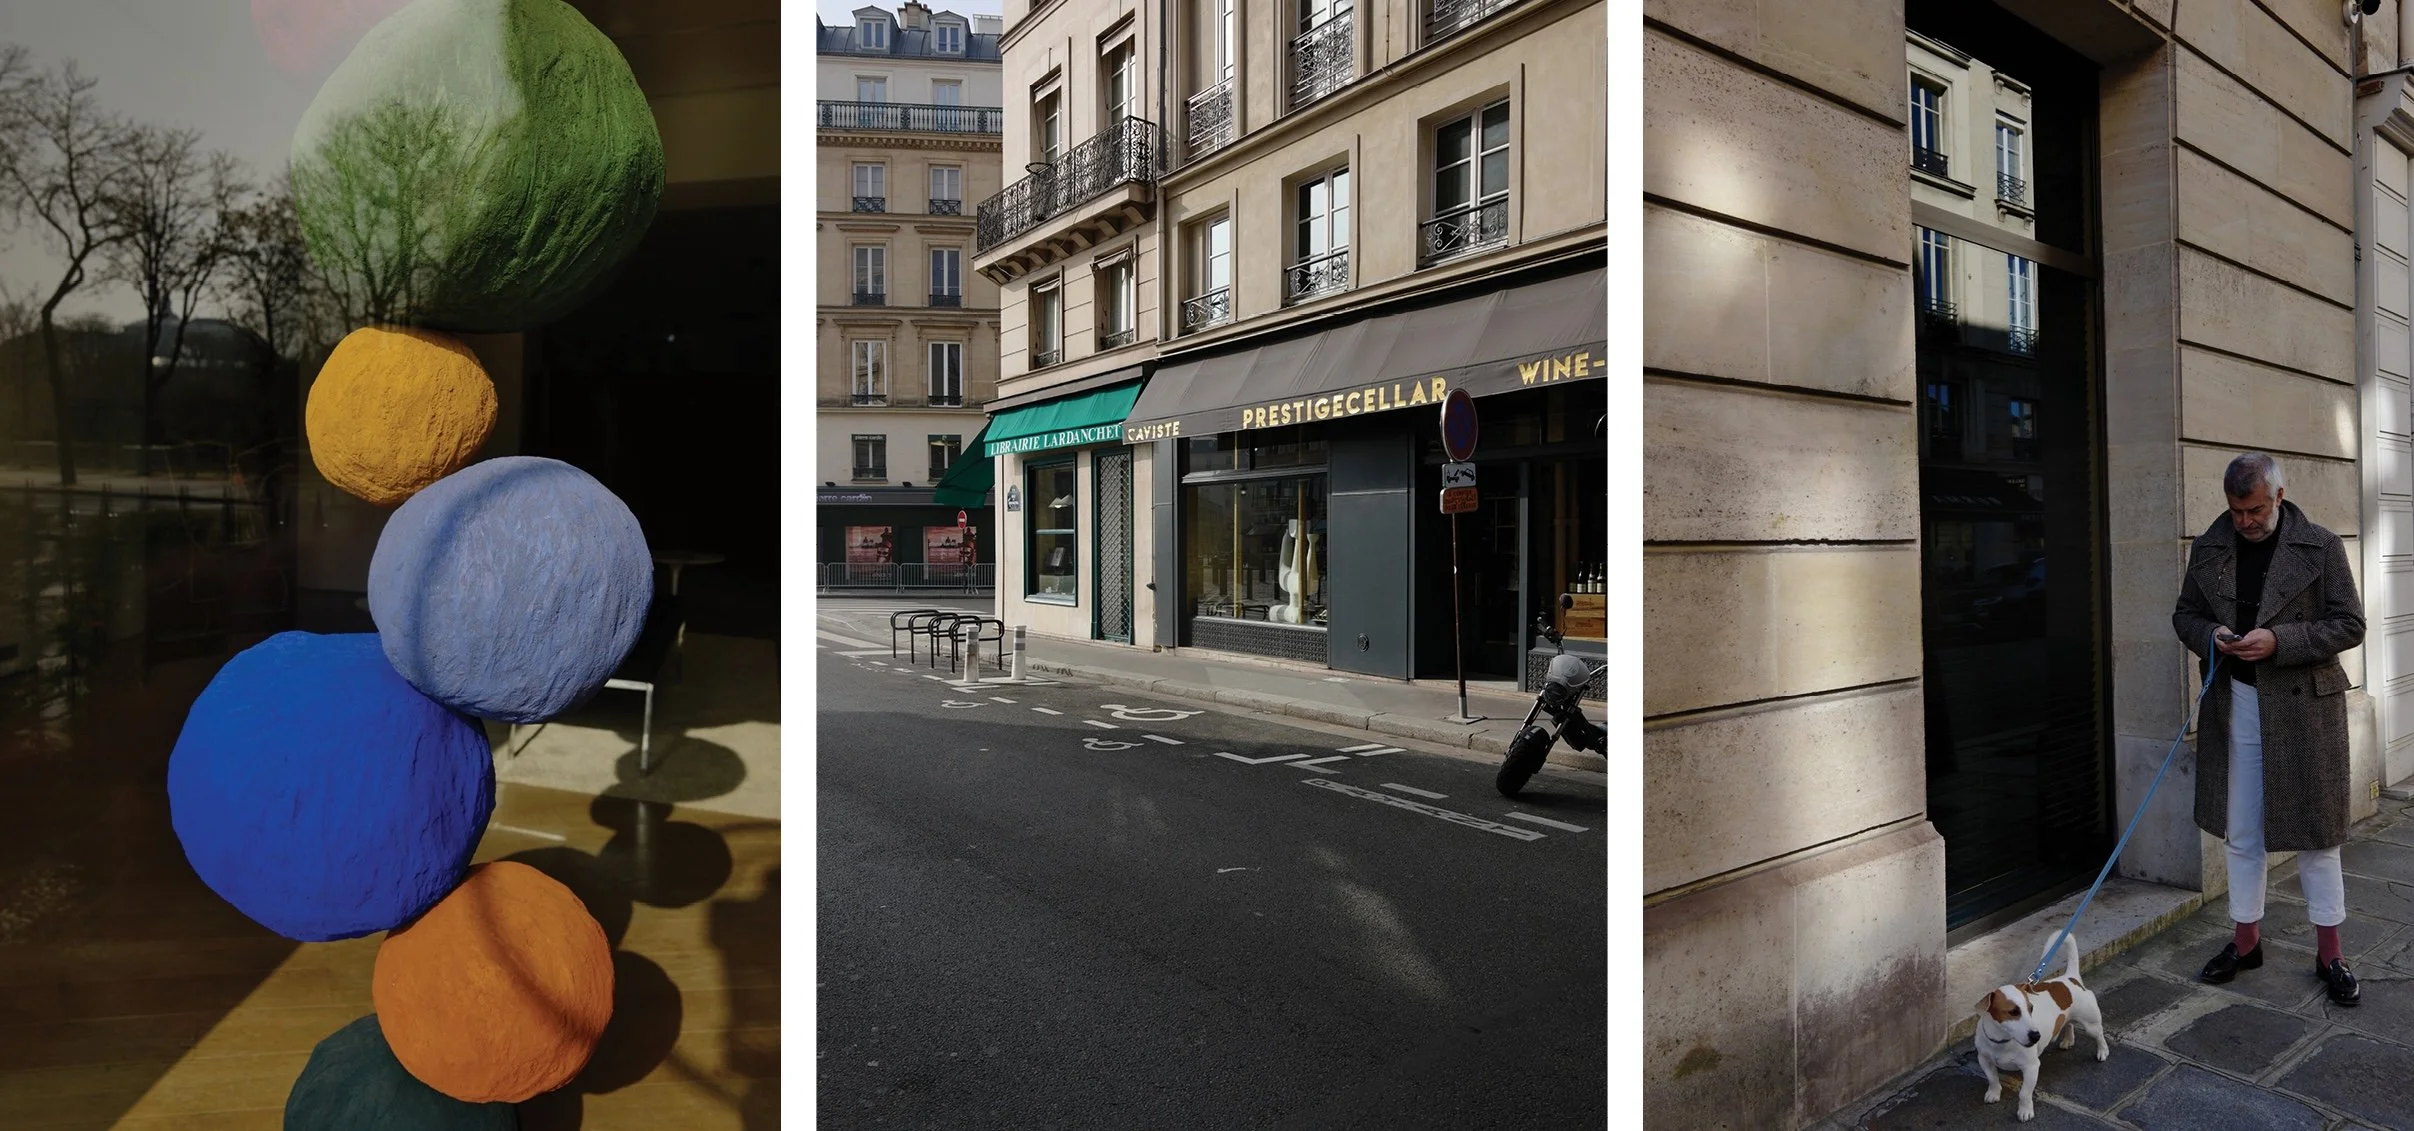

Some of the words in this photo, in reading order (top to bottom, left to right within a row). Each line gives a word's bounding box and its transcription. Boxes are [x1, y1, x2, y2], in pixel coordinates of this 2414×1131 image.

[1242, 376, 1447, 429] PRESTIGECELLAR
[991, 435, 1040, 455] LIBRAIRIE
[1044, 424, 1122, 449] LARDANCHET
[1128, 421, 1179, 442] CAVISTE
